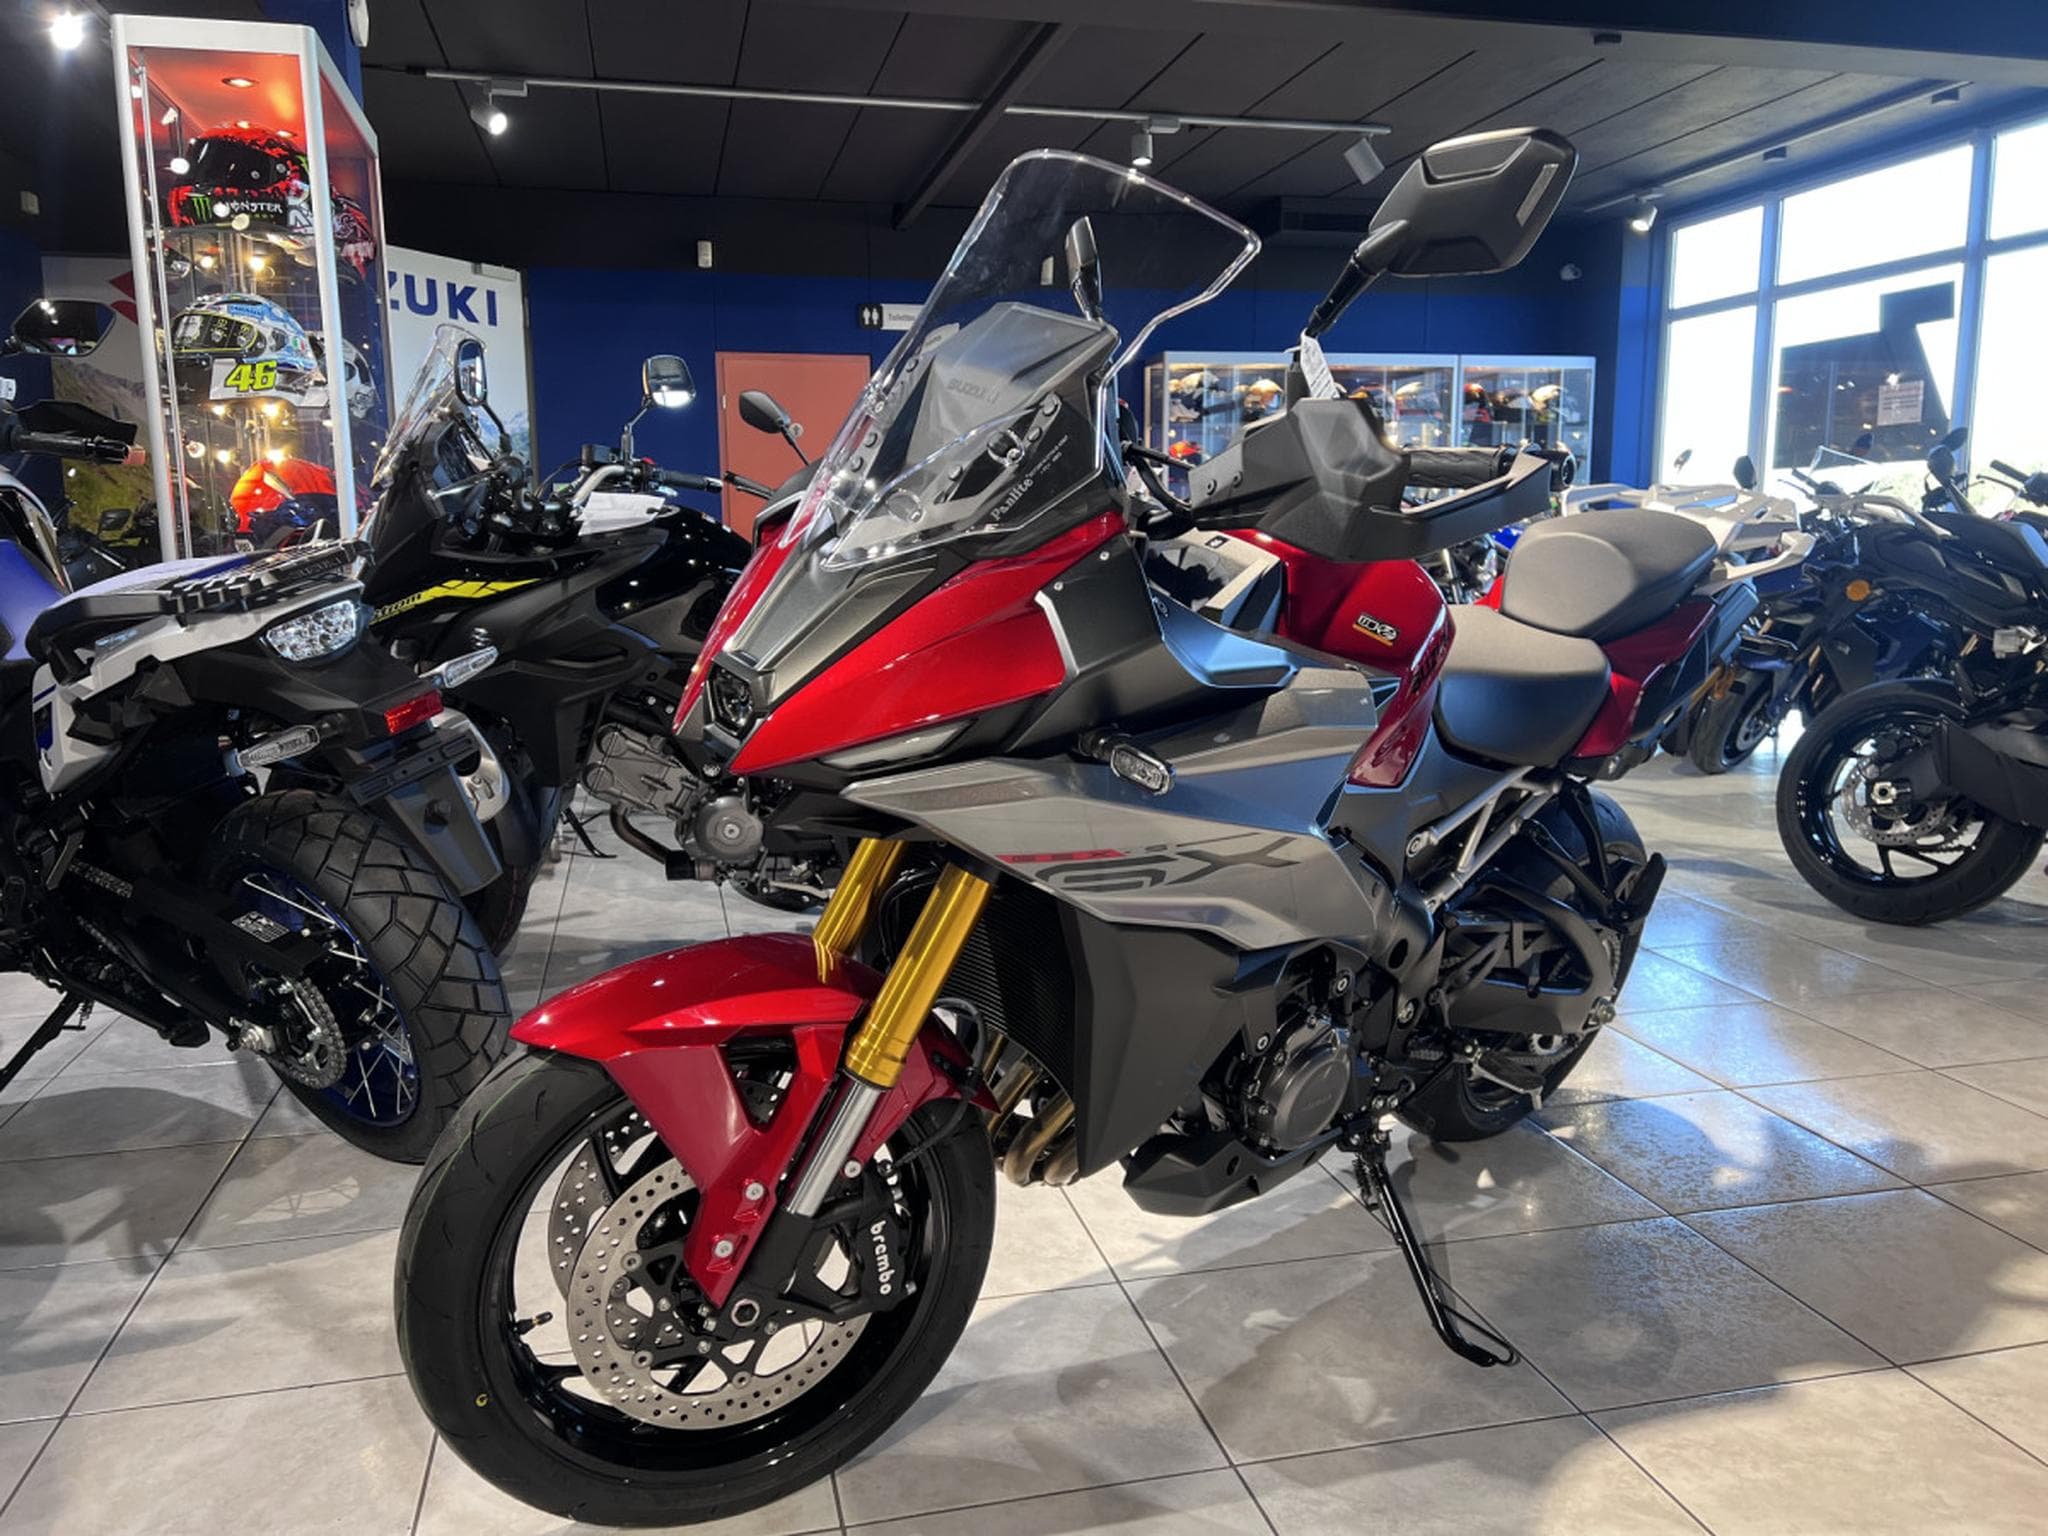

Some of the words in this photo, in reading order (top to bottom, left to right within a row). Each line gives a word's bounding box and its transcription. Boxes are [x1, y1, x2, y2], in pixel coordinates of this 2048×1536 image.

[213, 200, 283, 214] ONSTER
[225, 360, 278, 392] 46
[990, 478, 1034, 521] Panlite
[870, 1220, 895, 1295] brembo
